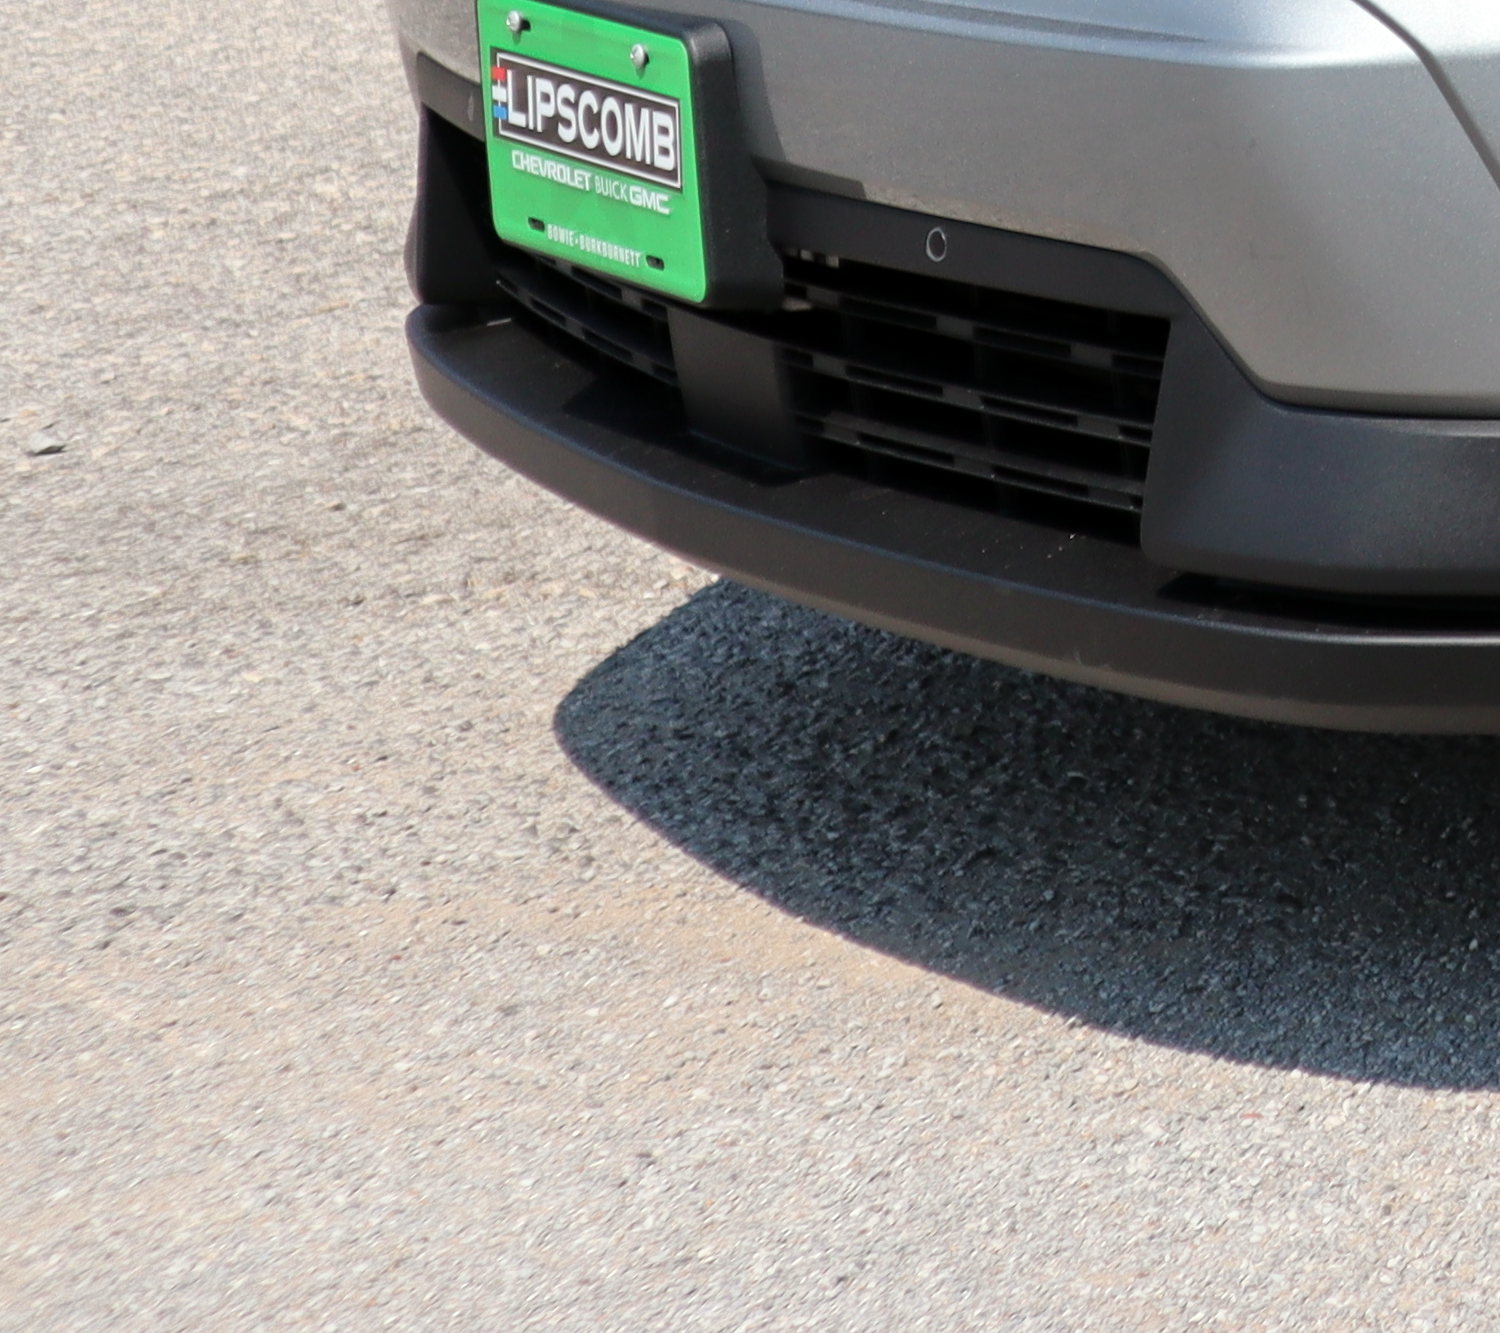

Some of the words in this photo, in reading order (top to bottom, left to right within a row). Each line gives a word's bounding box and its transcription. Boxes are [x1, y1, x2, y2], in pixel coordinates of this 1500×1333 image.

[506, 69, 675, 171] LIPSCOMB
[511, 149, 592, 192] CHEVROLET
[594, 175, 629, 203] BUICK
[629, 185, 671, 215] GMC
